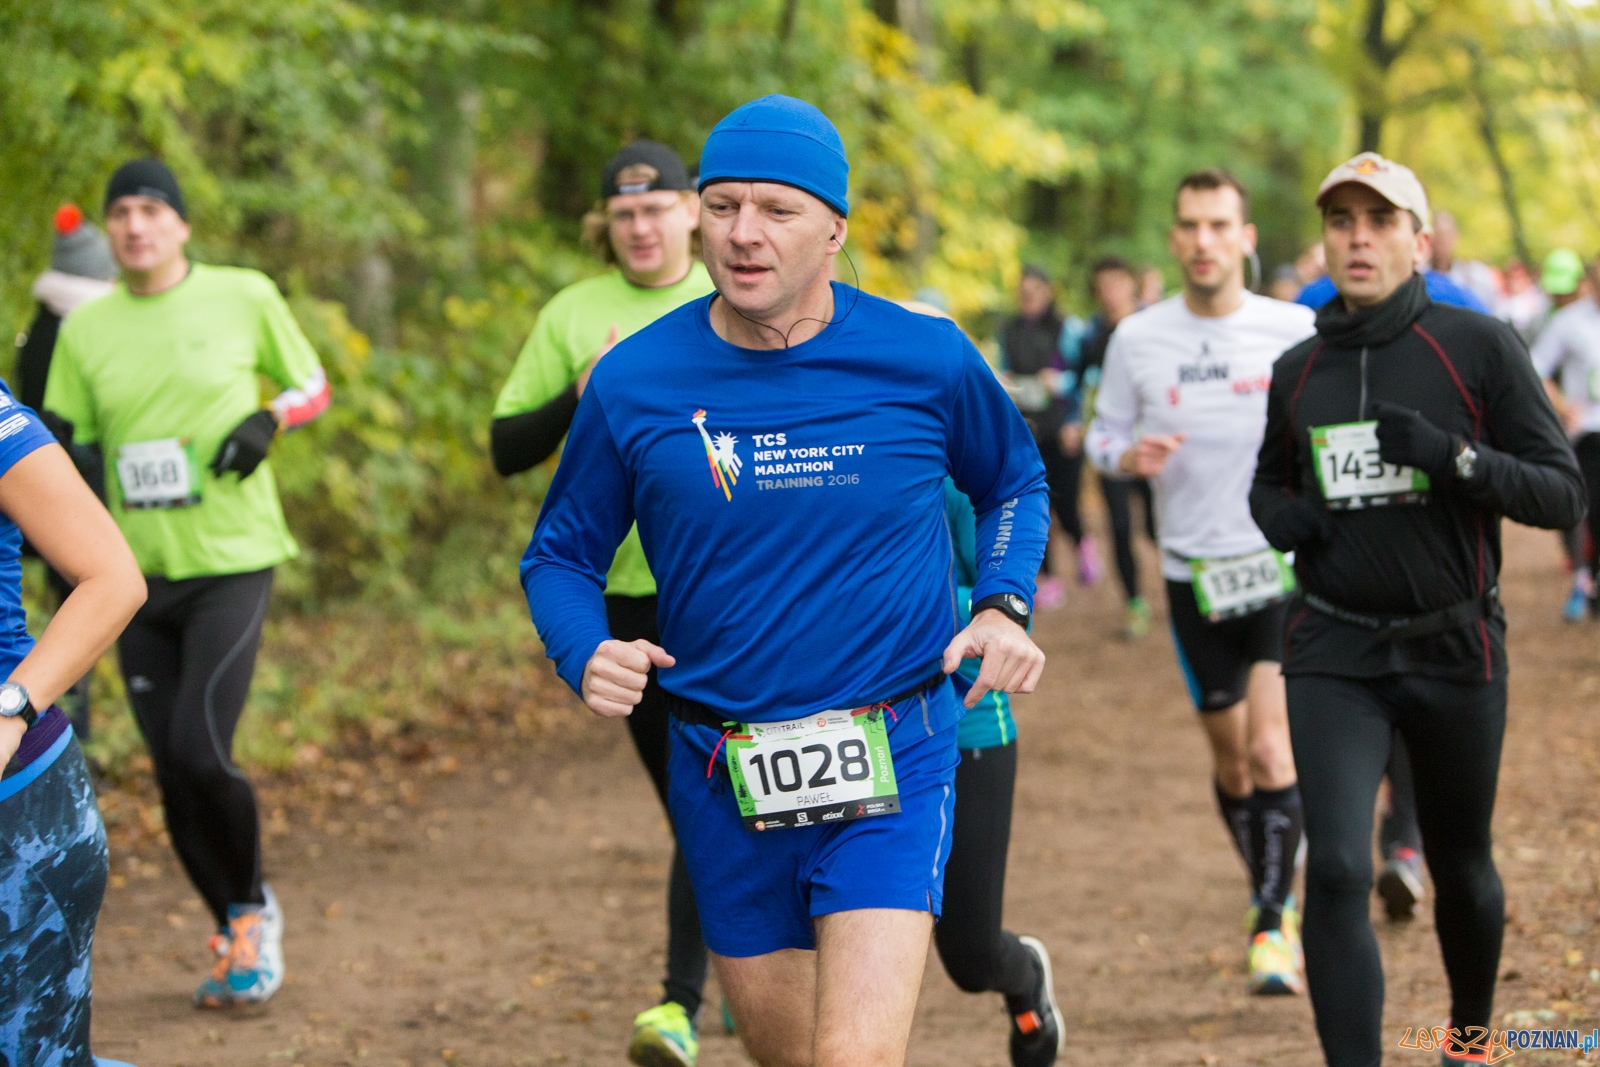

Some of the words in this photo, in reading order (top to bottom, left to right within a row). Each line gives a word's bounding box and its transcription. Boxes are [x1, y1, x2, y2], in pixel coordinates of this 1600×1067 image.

[752, 432, 787, 447] TCS
[753, 449, 786, 461] NEW
[789, 446, 829, 459] YORK
[831, 444, 866, 457] CITY
[754, 460, 834, 476] MARATHON
[756, 475, 824, 491] TRAINING
[827, 473, 860, 486] 2016
[749, 738, 870, 796] 1028
[874, 746, 889, 782] Poznań
[796, 792, 834, 807] PAWEŁ
